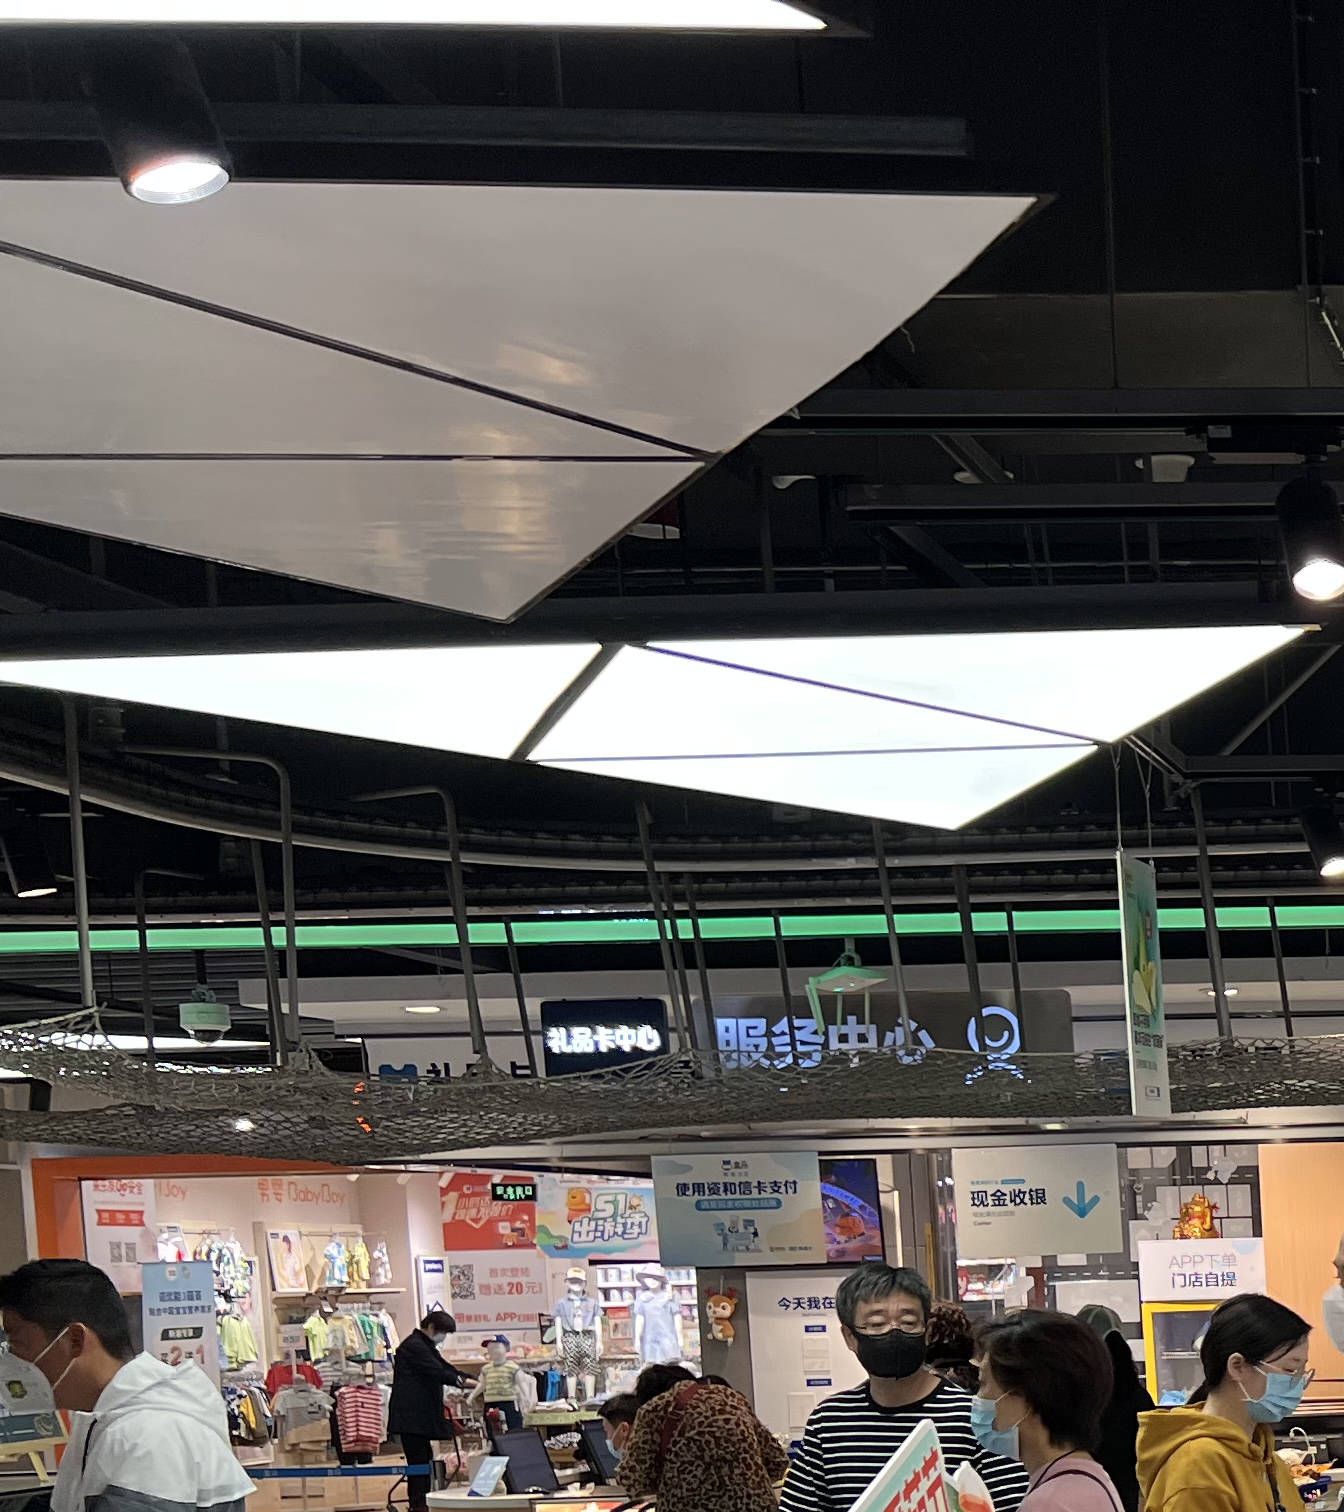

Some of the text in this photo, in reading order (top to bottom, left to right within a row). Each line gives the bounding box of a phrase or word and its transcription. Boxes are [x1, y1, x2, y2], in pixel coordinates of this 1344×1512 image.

[546, 1024, 662, 1054] 礼品卡中心
[716, 1013, 936, 1070] 服务中心
[675, 1180, 798, 1197] 使用资和信卡支付
[970, 1187, 1047, 1207] 现金收银
[1169, 1252, 1237, 1270] APP下单
[1171, 1271, 1237, 1289] 门店自提
[778, 1296, 836, 1311] 今天我在
